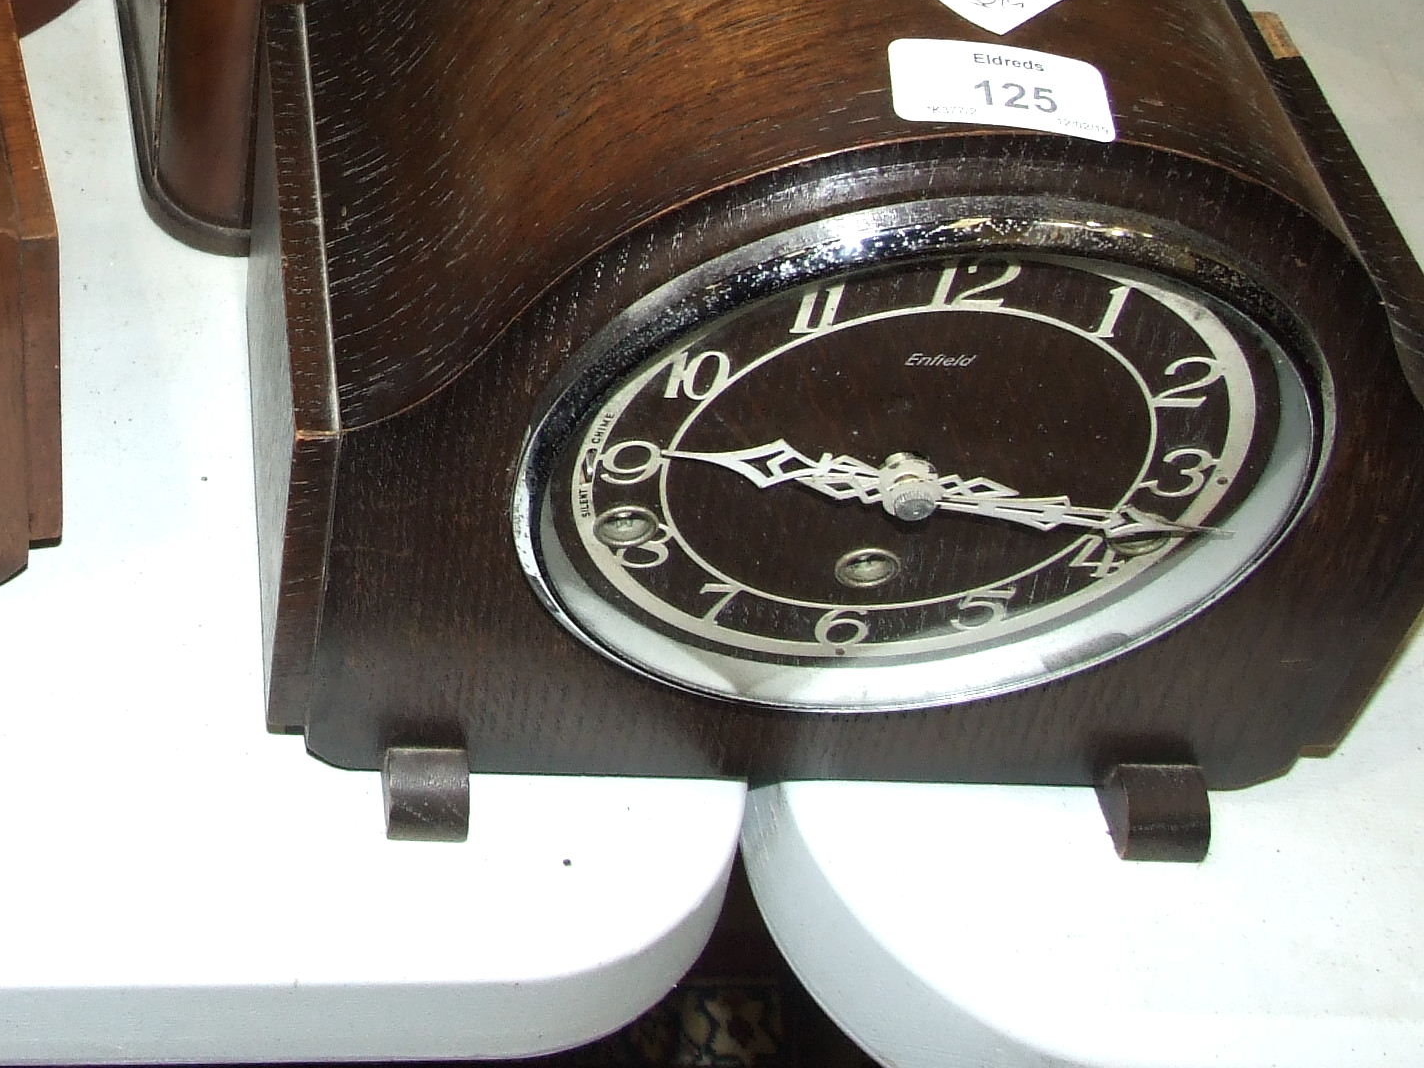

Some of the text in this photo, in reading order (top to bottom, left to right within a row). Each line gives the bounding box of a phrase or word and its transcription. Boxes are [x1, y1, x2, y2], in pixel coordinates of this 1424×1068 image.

[973, 53, 1045, 72] Eldreds
[974, 80, 1058, 114] 125
[929, 265, 1022, 308] 12
[789, 284, 845, 334] 11
[1091, 286, 1132, 337] 1
[663, 350, 730, 401] 10
[904, 353, 977, 368] Enfield
[1153, 356, 1224, 407] 2
[592, 412, 614, 443] CHIME
[600, 440, 663, 484] 9
[1138, 448, 1209, 497] 3
[578, 489, 590, 518] SILENT
[699, 583, 744, 626] 7
[950, 586, 1016, 630] 5
[814, 608, 871, 645] 6
